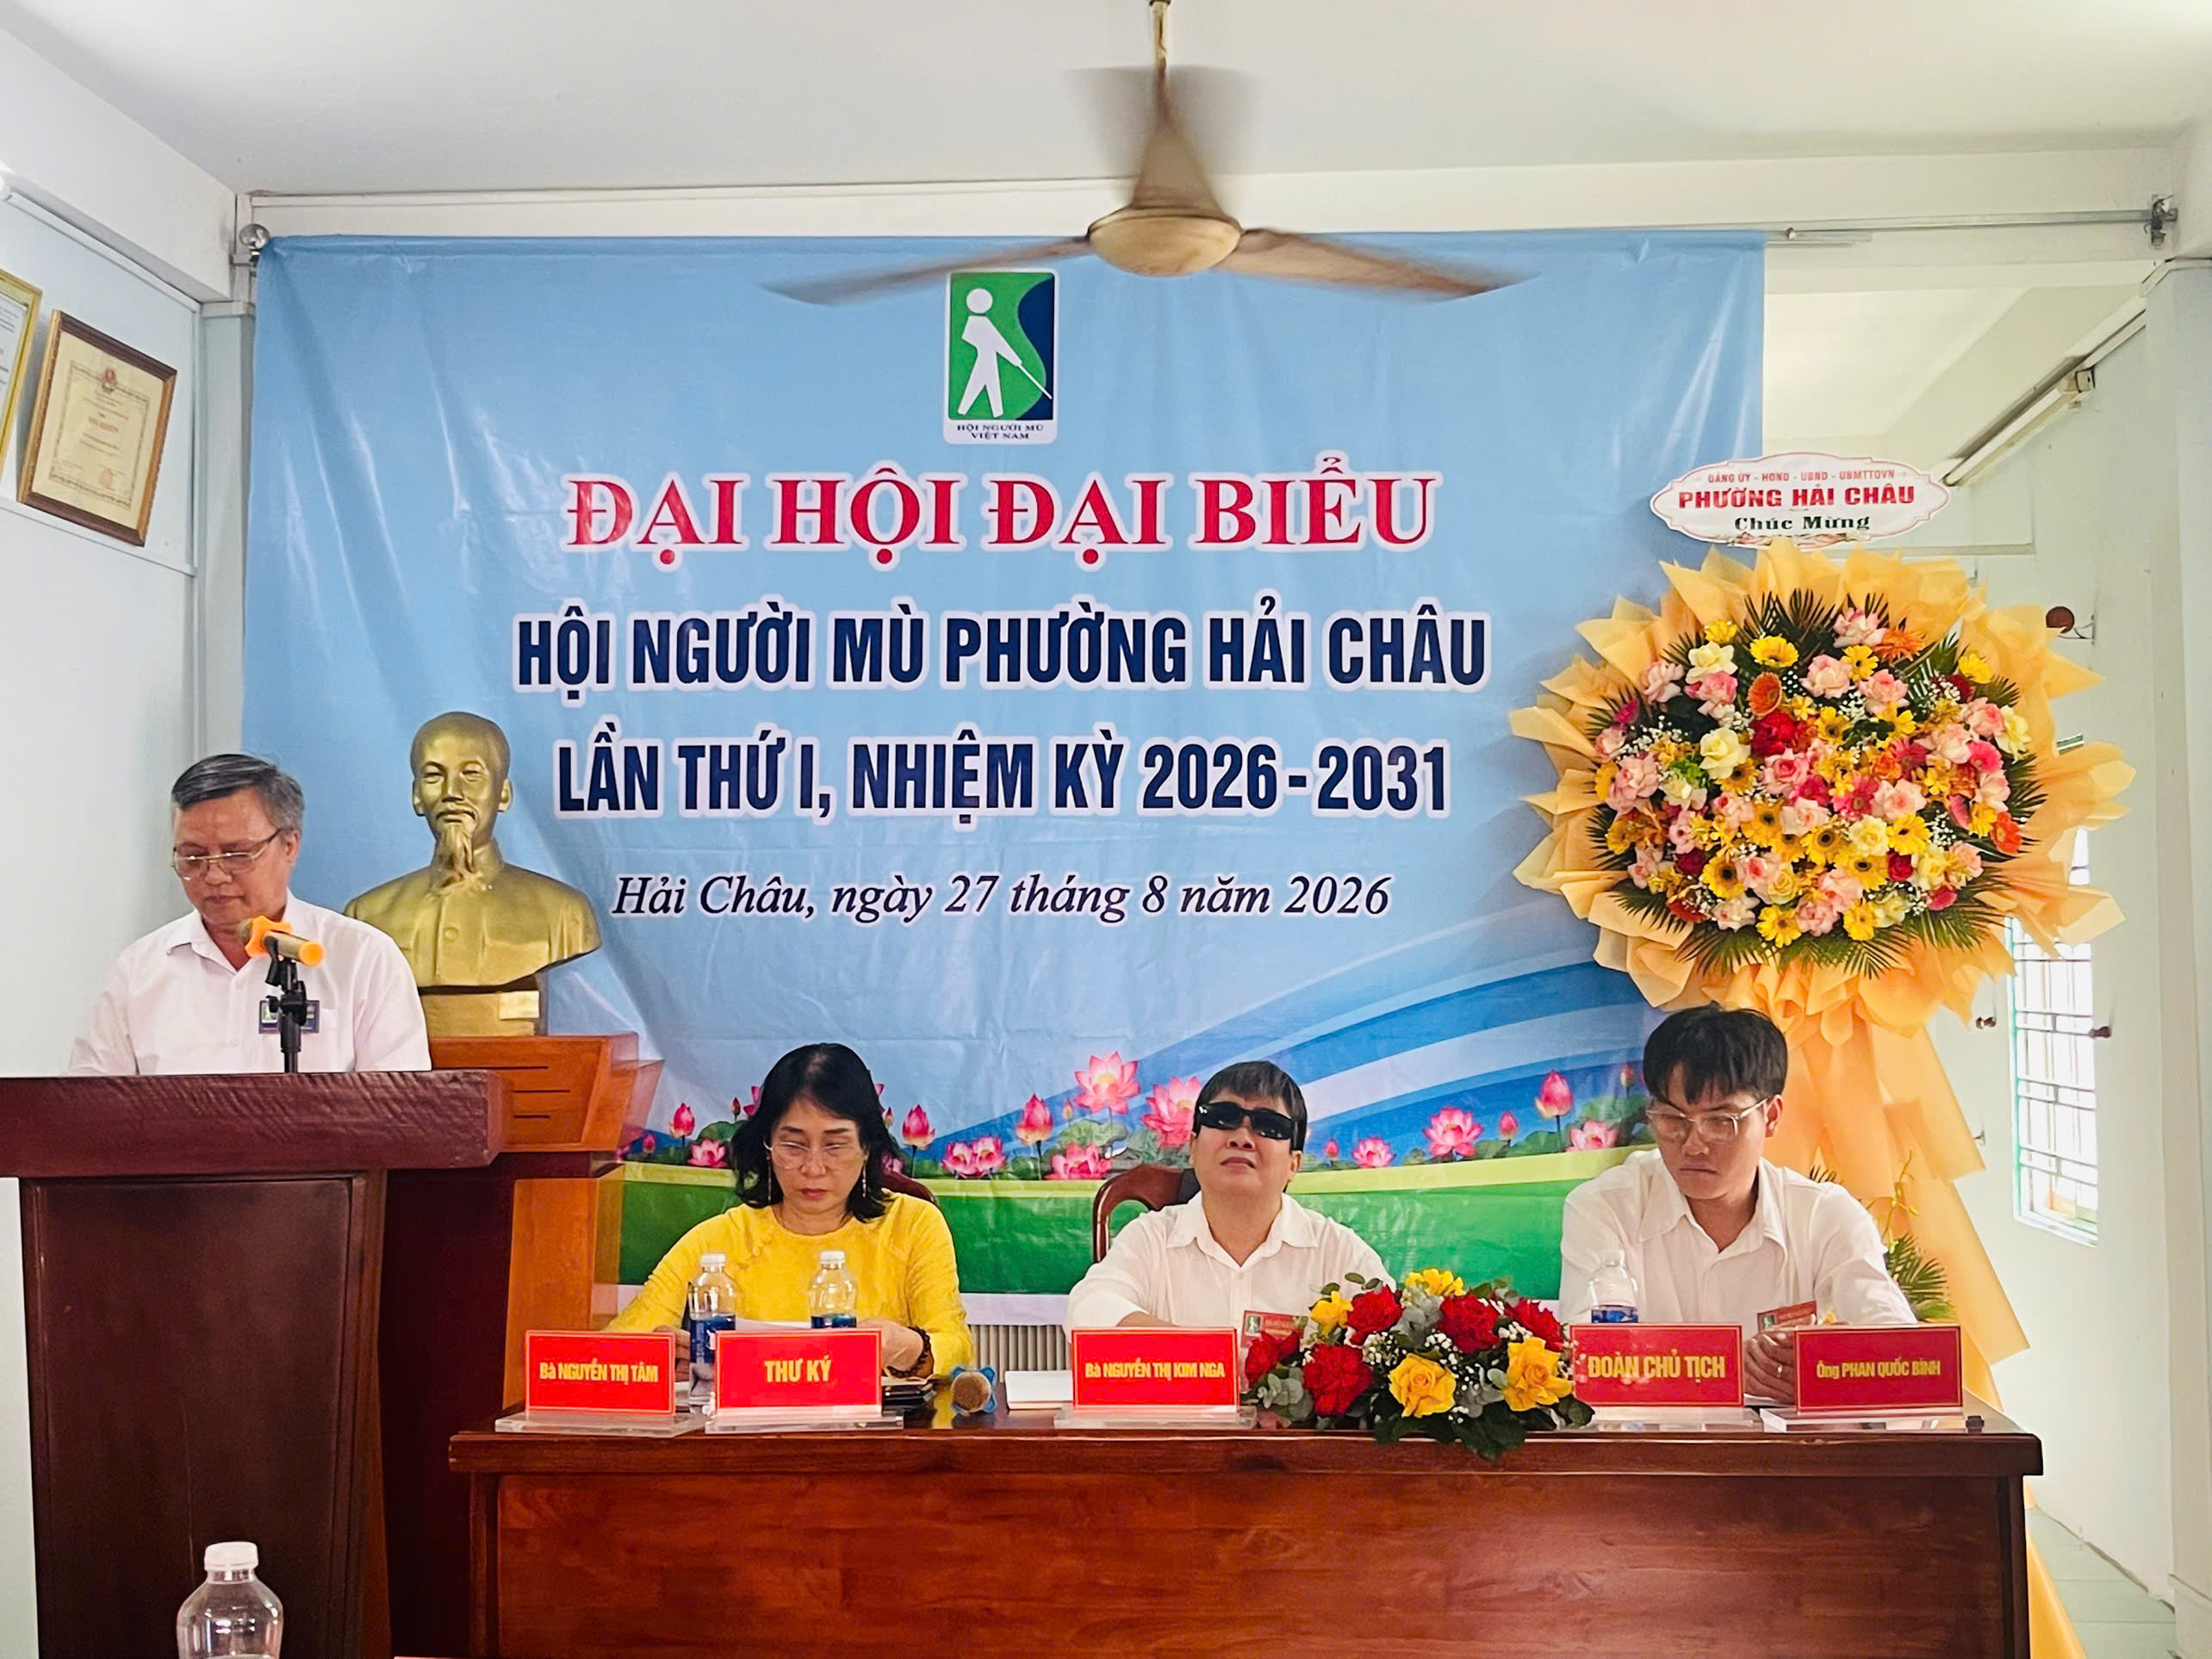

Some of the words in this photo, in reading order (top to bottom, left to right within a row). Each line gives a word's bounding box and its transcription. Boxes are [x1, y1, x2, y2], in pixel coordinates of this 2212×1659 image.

[567, 479, 744, 565] ĐẠI
[771, 467, 959, 565] HỘI
[988, 479, 1167, 565] ĐẠI
[1194, 457, 1437, 545] BIỂU
[1679, 485, 1782, 509] PHƯỜNG
[1793, 483, 1834, 506] HẢI
[1845, 483, 1915, 506] CHÂU
[1734, 517, 1793, 531] Chúc
[1803, 515, 1870, 531] Mừng
[519, 606, 611, 700] HỘI
[632, 601, 811, 684] NGƯỜI
[832, 604, 924, 683] MÙ
[946, 600, 1186, 684] PHƯỜNG
[1209, 594, 1305, 684] HẢI
[1327, 604, 1485, 686] CHÂU
[558, 722, 659, 811] LẦN
[677, 730, 786, 811] THỨ
[799, 743, 832, 818] I,
[853, 729, 1033, 824] NHIỆM
[1054, 730, 1125, 809] KỲ
[612, 876, 687, 916] Hải
[699, 875, 816, 919] Châu,
[831, 875, 933, 924] ngày
[944, 875, 999, 913] 27
[1010, 873, 1131, 924] tháng
[1142, 875, 1169, 914] 8
[1180, 878, 1271, 914] năm
[1283, 876, 1393, 915] 2026
[539, 1362, 556, 1380] Bà
[609, 1364, 629, 1385] THỊ
[631, 1361, 659, 1382] TÂM
[765, 1358, 804, 1383] THƯ
[806, 1351, 832, 1382] KÝ
[1084, 1363, 1102, 1378] Bà
[1152, 1363, 1172, 1382] THỊ
[1173, 1363, 1198, 1378] KIM
[1199, 1363, 1226, 1378] NGA
[1588, 1351, 1640, 1379] ĐOÀN
[1643, 1348, 1681, 1379] CHỦ
[1684, 1356, 1726, 1383] TỊCH
[1817, 1359, 1840, 1380] Ông
[1842, 1362, 1875, 1378] PHAN
[1877, 1356, 1910, 1378] QUỐC
